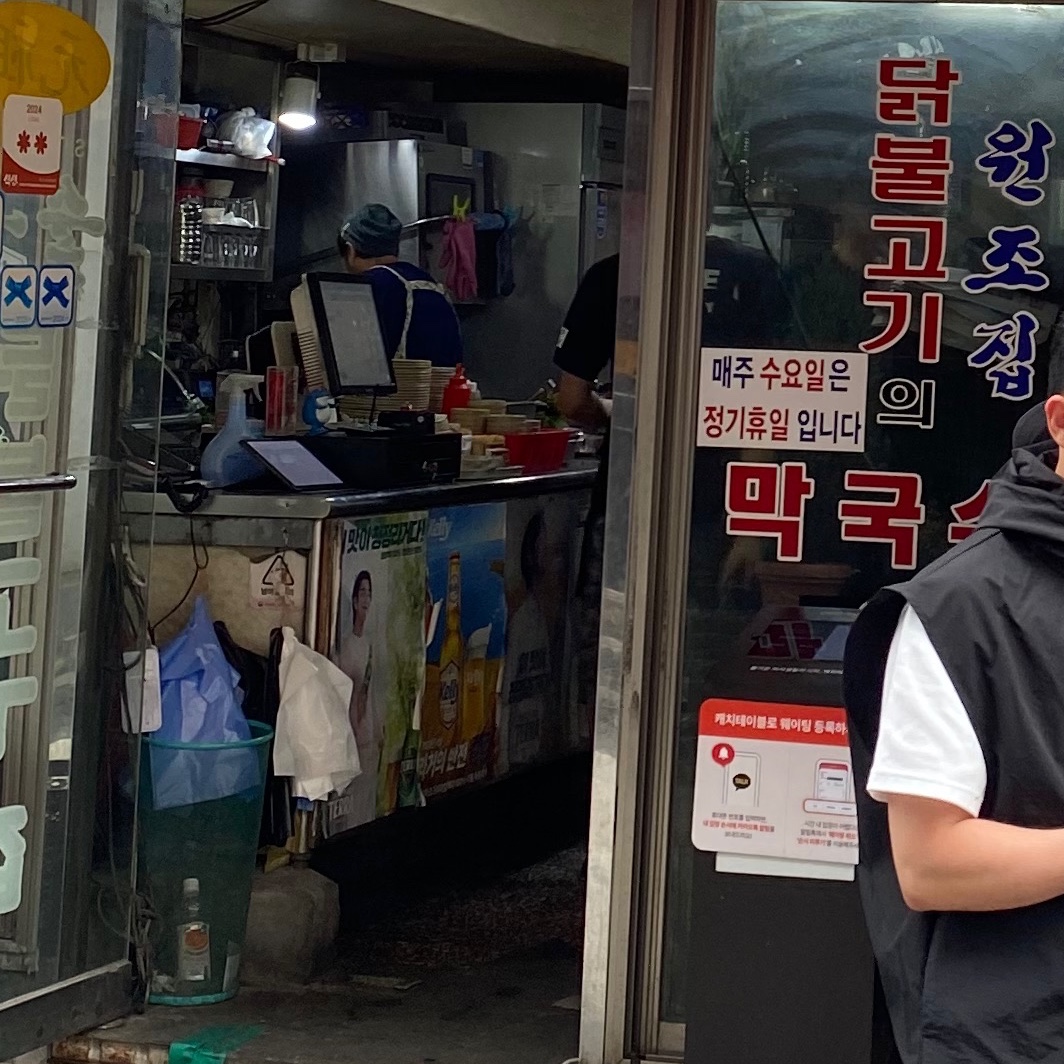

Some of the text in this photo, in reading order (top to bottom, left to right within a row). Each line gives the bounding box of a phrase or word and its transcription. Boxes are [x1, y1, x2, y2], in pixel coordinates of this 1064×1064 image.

[711, 355, 852, 394] 매주 수요일은
[702, 405, 863, 446] 정기휴일 입니다
[814, 721, 848, 735] 등록하
